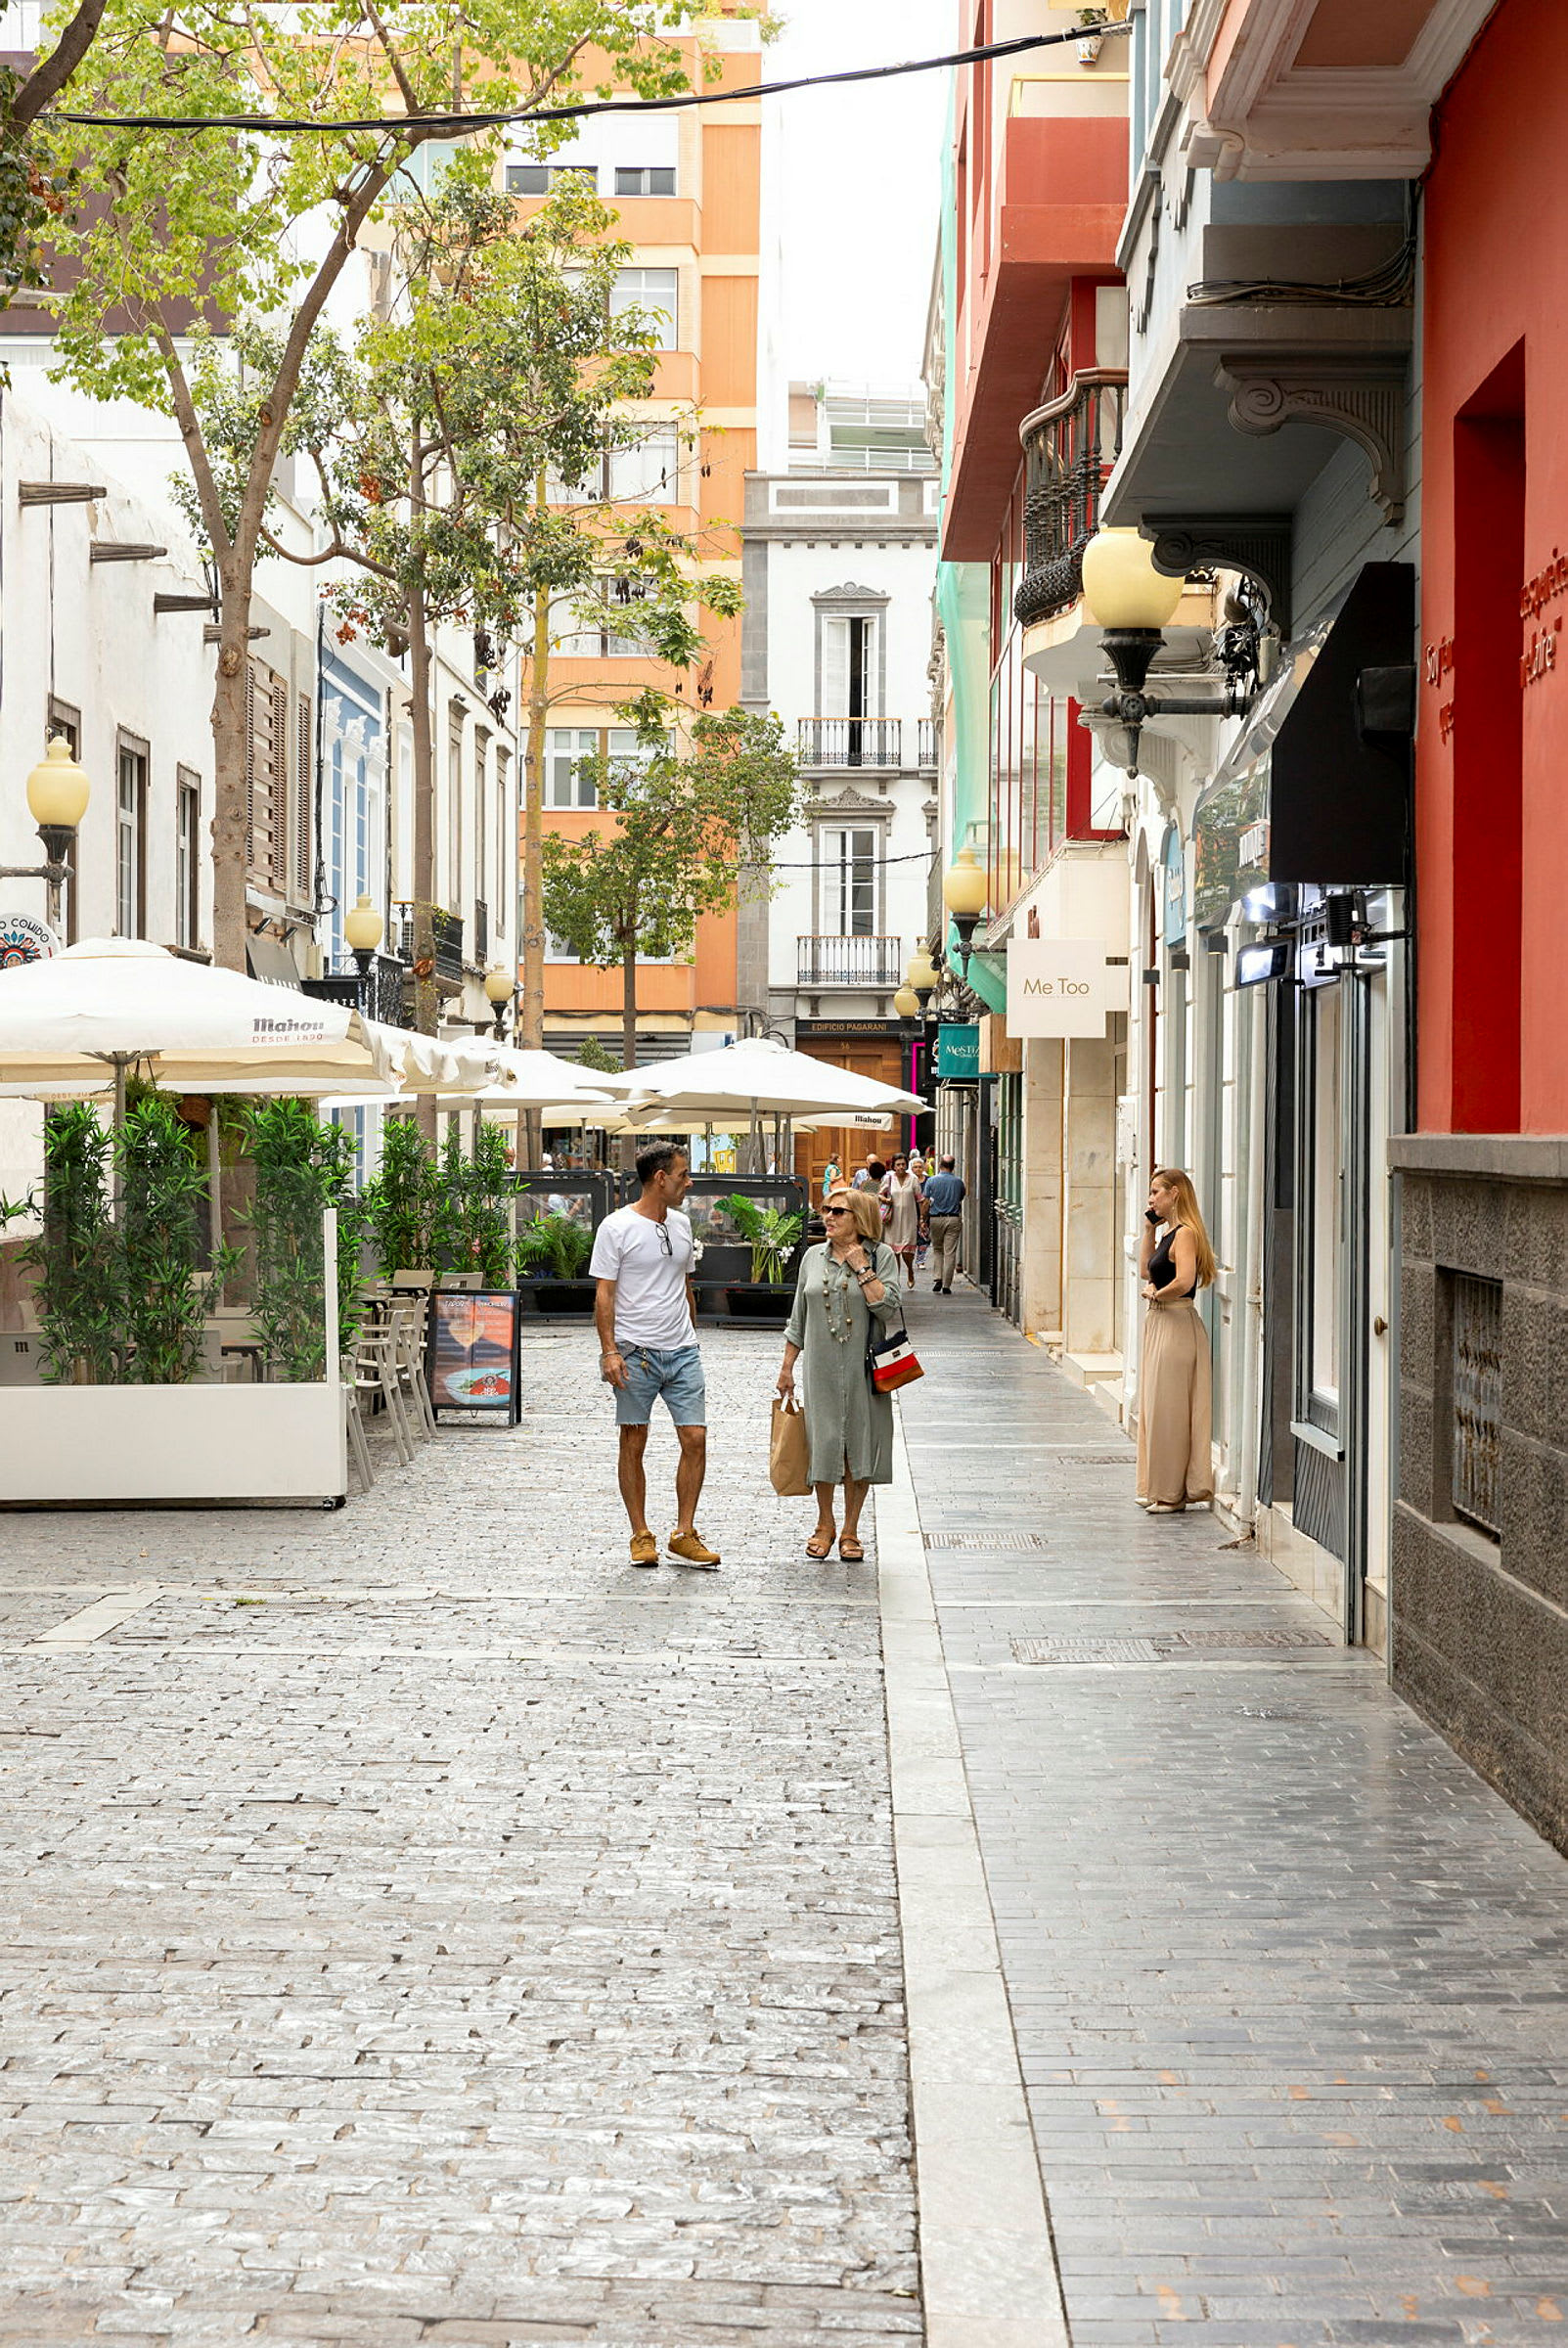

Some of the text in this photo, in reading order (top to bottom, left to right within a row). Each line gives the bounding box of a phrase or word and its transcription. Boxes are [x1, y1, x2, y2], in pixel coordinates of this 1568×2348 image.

[1023, 977, 1090, 995] Me Too
[252, 1017, 324, 1033] Mahou
[812, 1022, 887, 1031] EDIFICIO PAGARANI
[251, 1033, 323, 1044] DESDE 1890
[855, 1114, 882, 1124] Mahou
